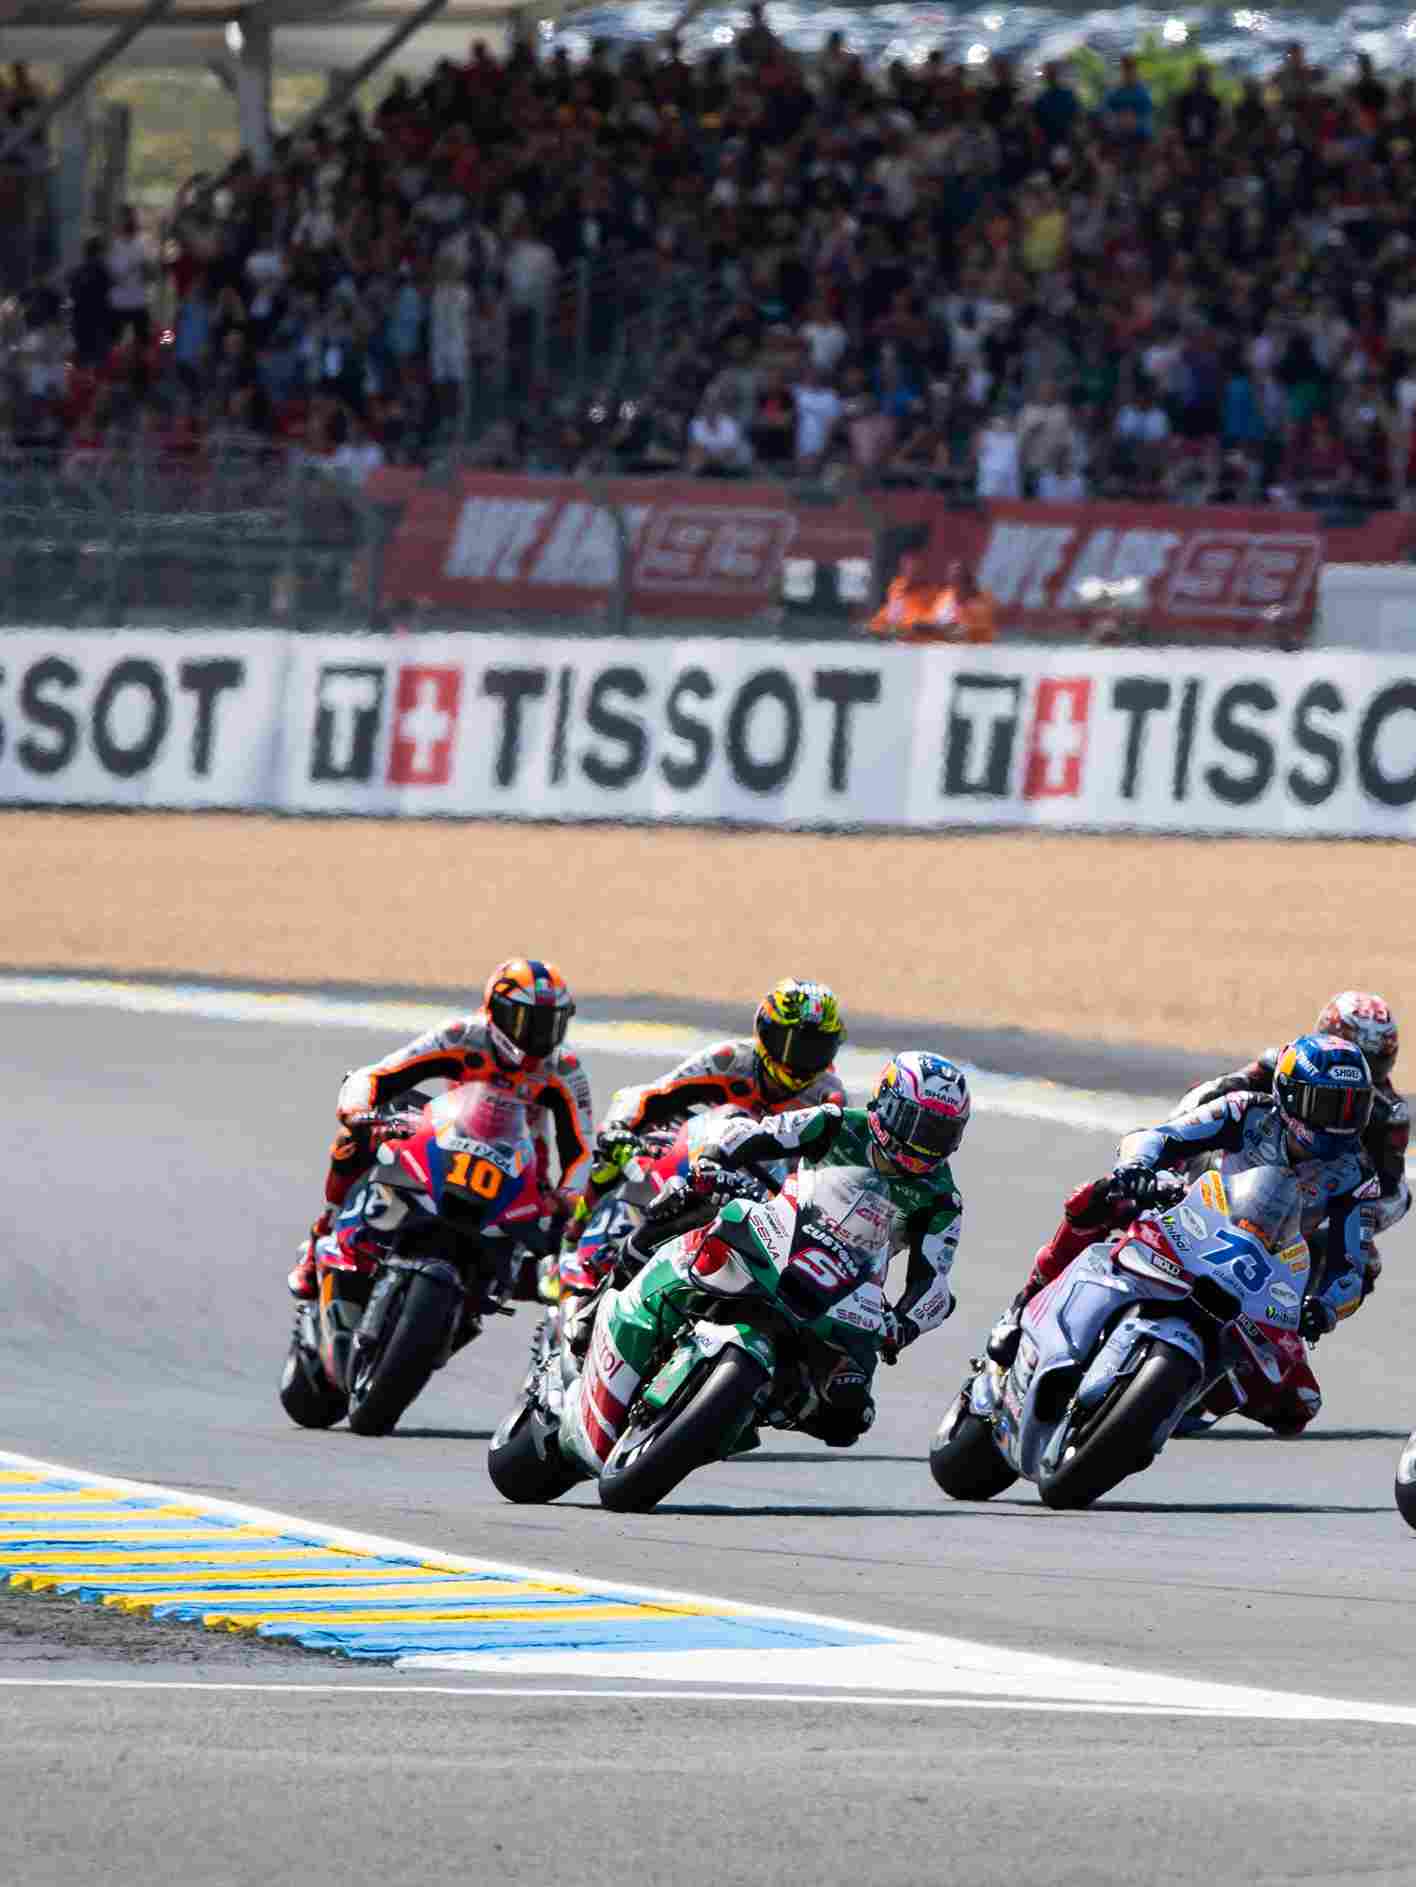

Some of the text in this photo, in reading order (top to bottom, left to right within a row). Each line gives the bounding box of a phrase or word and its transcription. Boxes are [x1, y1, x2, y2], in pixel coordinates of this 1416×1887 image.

[0, 655, 245, 779] SOT
[483, 666, 882, 793] TISSOT
[447, 1152, 503, 1200] 10
[749, 1214, 781, 1262] SENA
[1200, 1230, 1273, 1295] 73
